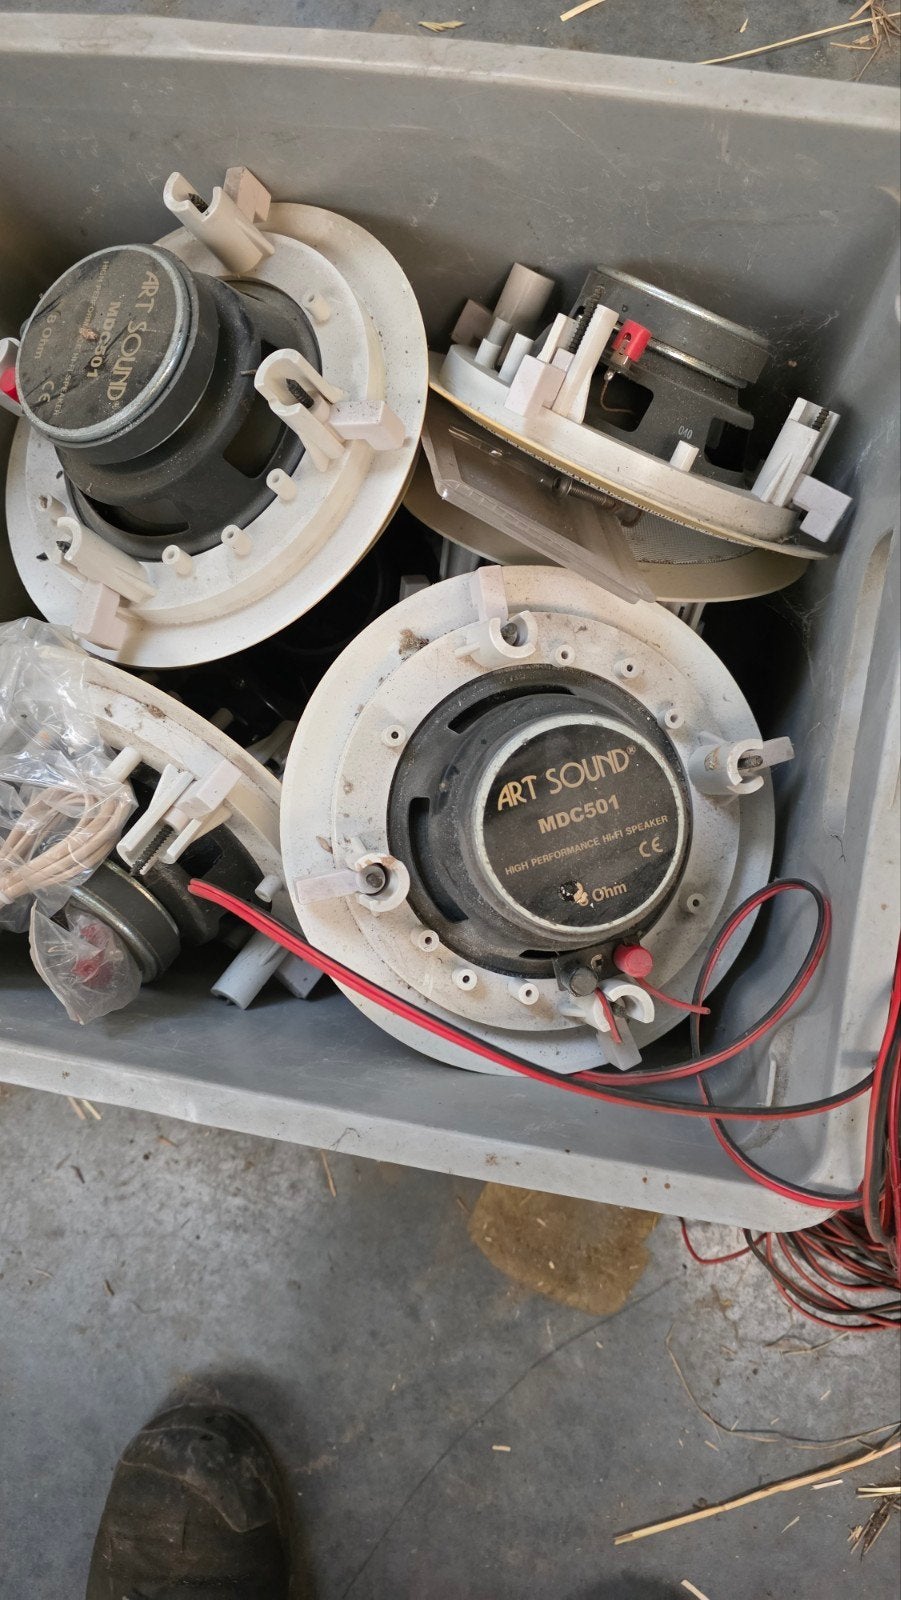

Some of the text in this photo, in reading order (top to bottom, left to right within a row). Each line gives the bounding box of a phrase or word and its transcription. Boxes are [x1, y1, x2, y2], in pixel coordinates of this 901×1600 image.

[135, 270, 160, 313] ART
[34, 327, 52, 360] Ohm
[86, 301, 121, 379] MDC501
[497, 775, 537, 811] ART
[537, 794, 620, 835] MDC501
[505, 815, 670, 876] HIGH PERFORMANCE HI-FI SPEAKER
[592, 882, 628, 902] Ohm
